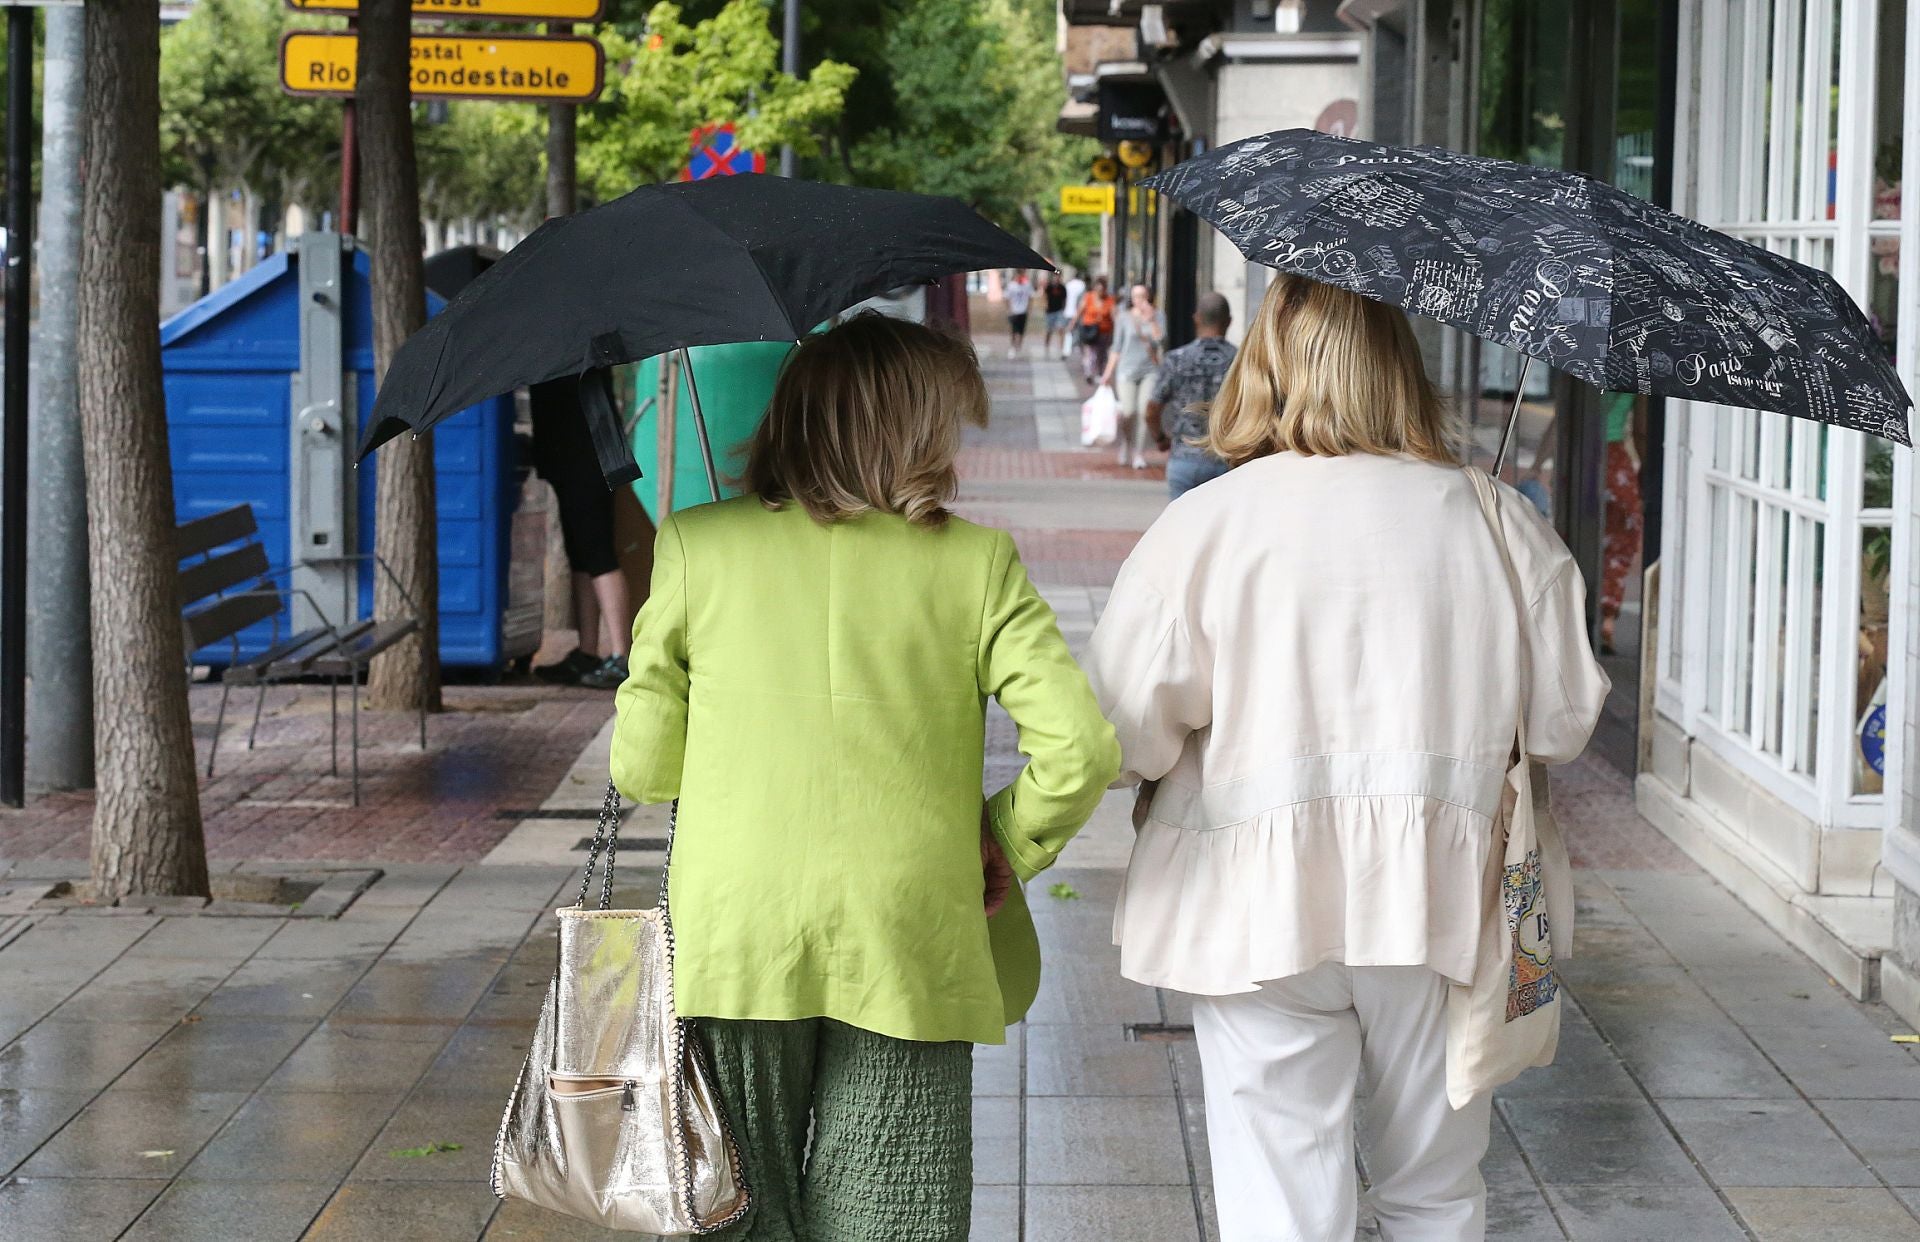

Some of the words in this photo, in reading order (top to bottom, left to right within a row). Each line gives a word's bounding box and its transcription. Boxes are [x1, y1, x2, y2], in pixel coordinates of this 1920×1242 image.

[410, 43, 462, 60] ostal
[409, 66, 570, 88] ondestable
[1313, 235, 1349, 256] Rain
[1675, 350, 1744, 387] Paris
[1813, 346, 1850, 370] Rain
